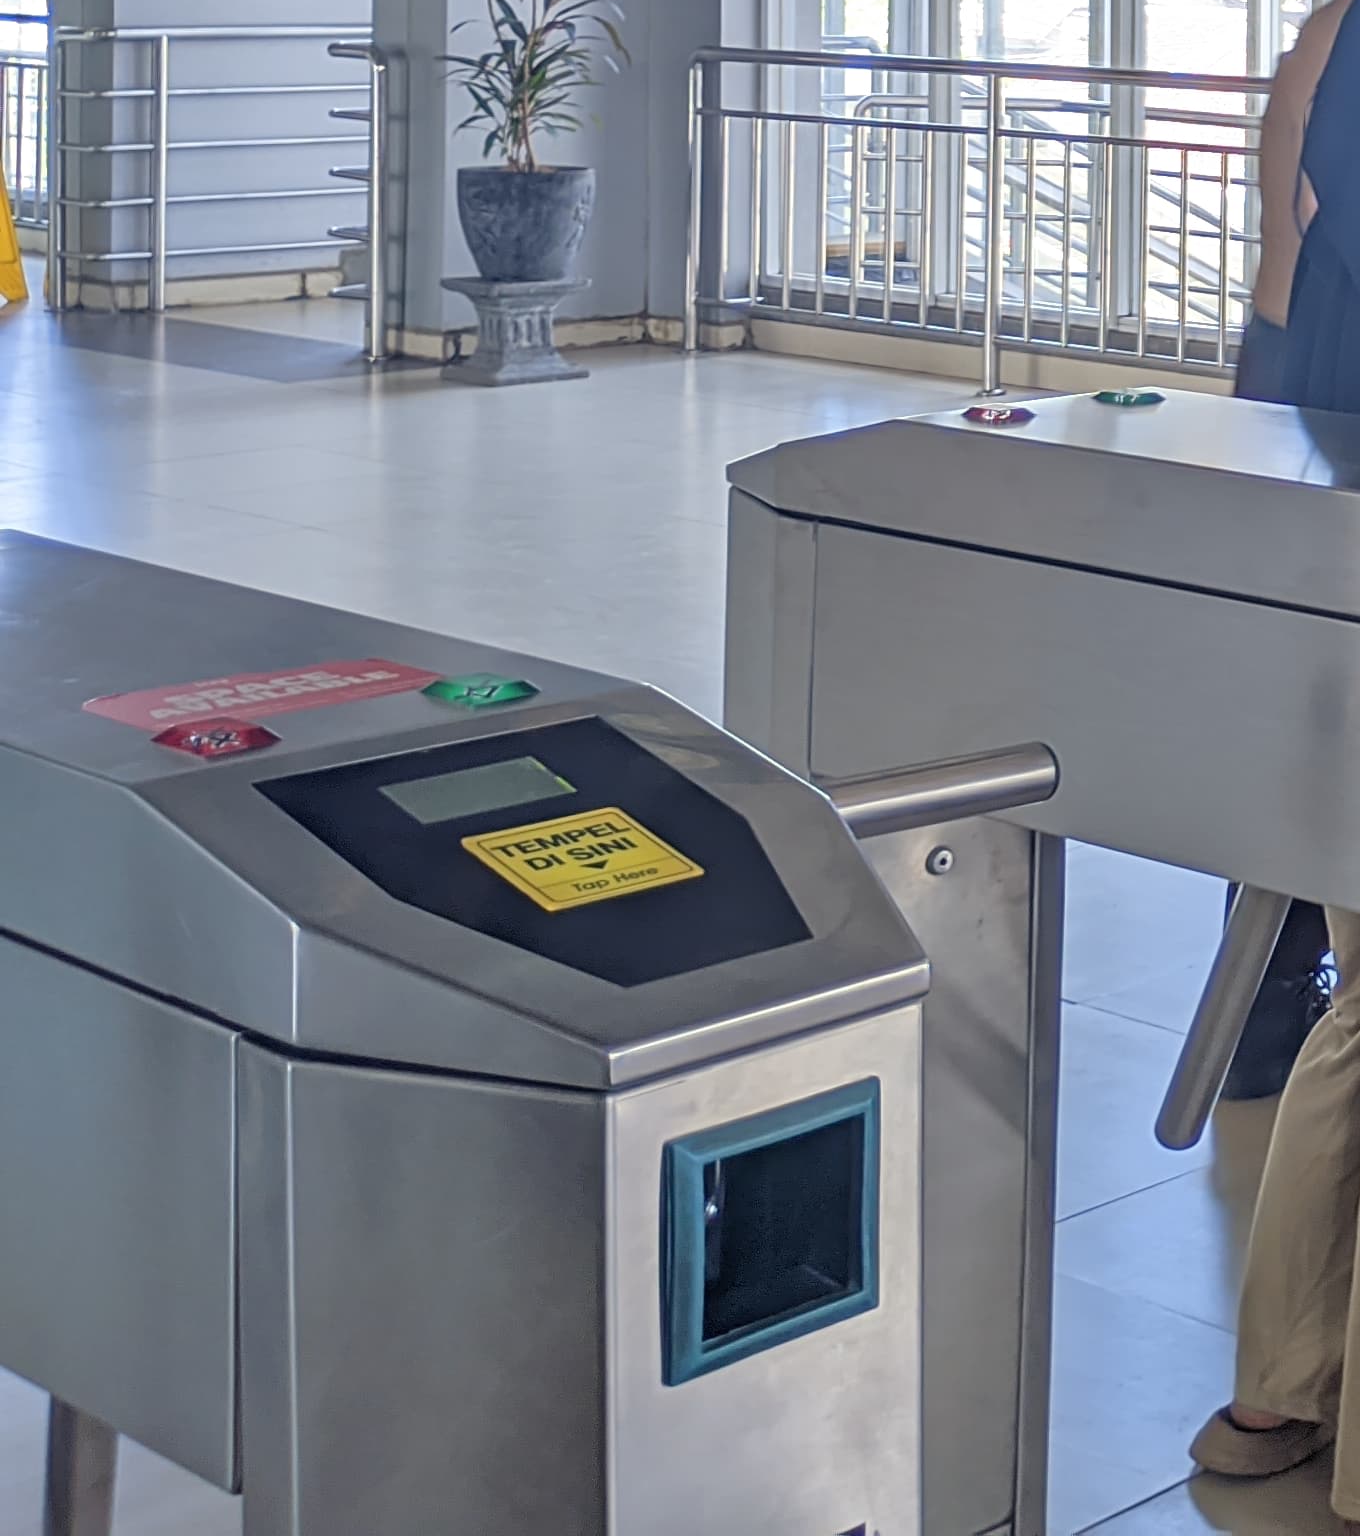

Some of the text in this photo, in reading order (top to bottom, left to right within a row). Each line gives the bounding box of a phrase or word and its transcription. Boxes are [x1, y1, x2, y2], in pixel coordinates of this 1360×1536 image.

[150, 670, 400, 720] AVAILABLE
[490, 821, 632, 857] TEMPEL
[524, 837, 638, 872] DI SINI
[571, 865, 659, 893] Tap Here
